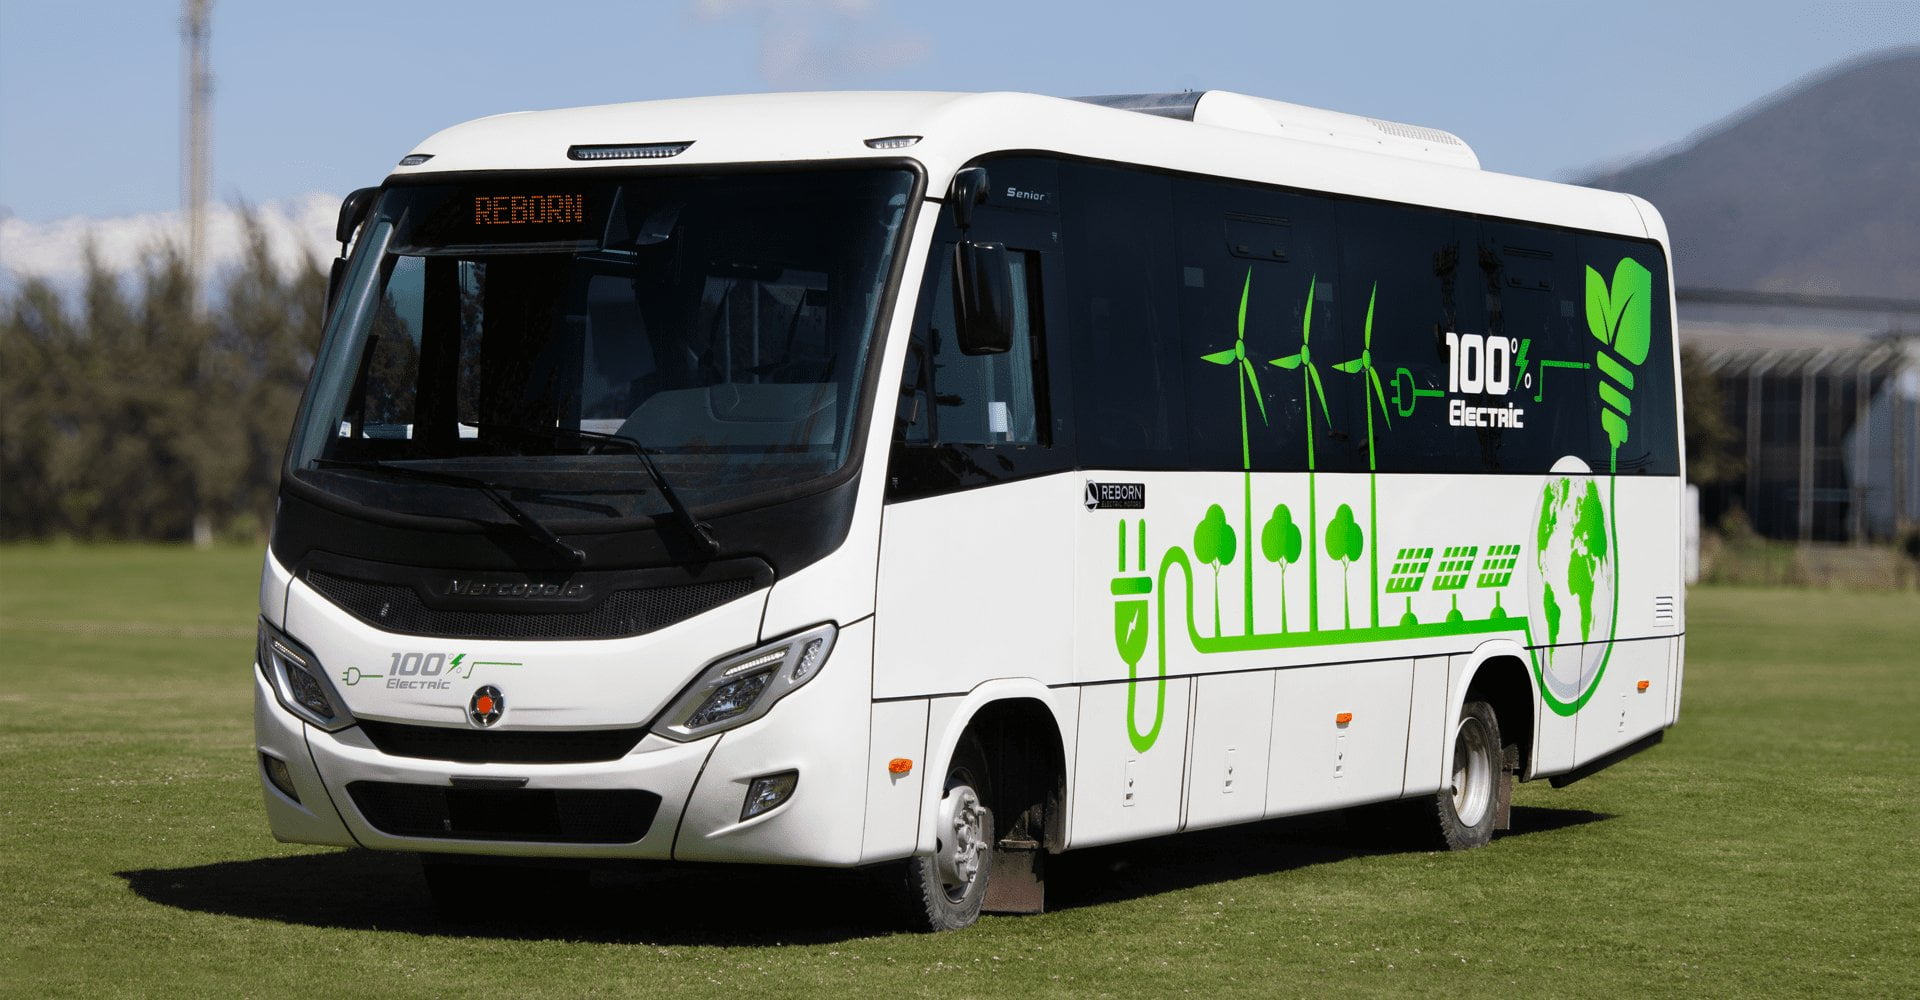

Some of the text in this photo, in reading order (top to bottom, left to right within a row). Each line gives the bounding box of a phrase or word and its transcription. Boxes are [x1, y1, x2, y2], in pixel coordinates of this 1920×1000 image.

[1006, 187, 1046, 201] Senior
[475, 194, 582, 225] REBORN
[1101, 485, 1142, 500] REBORN
[444, 579, 584, 598] Marcopolo
